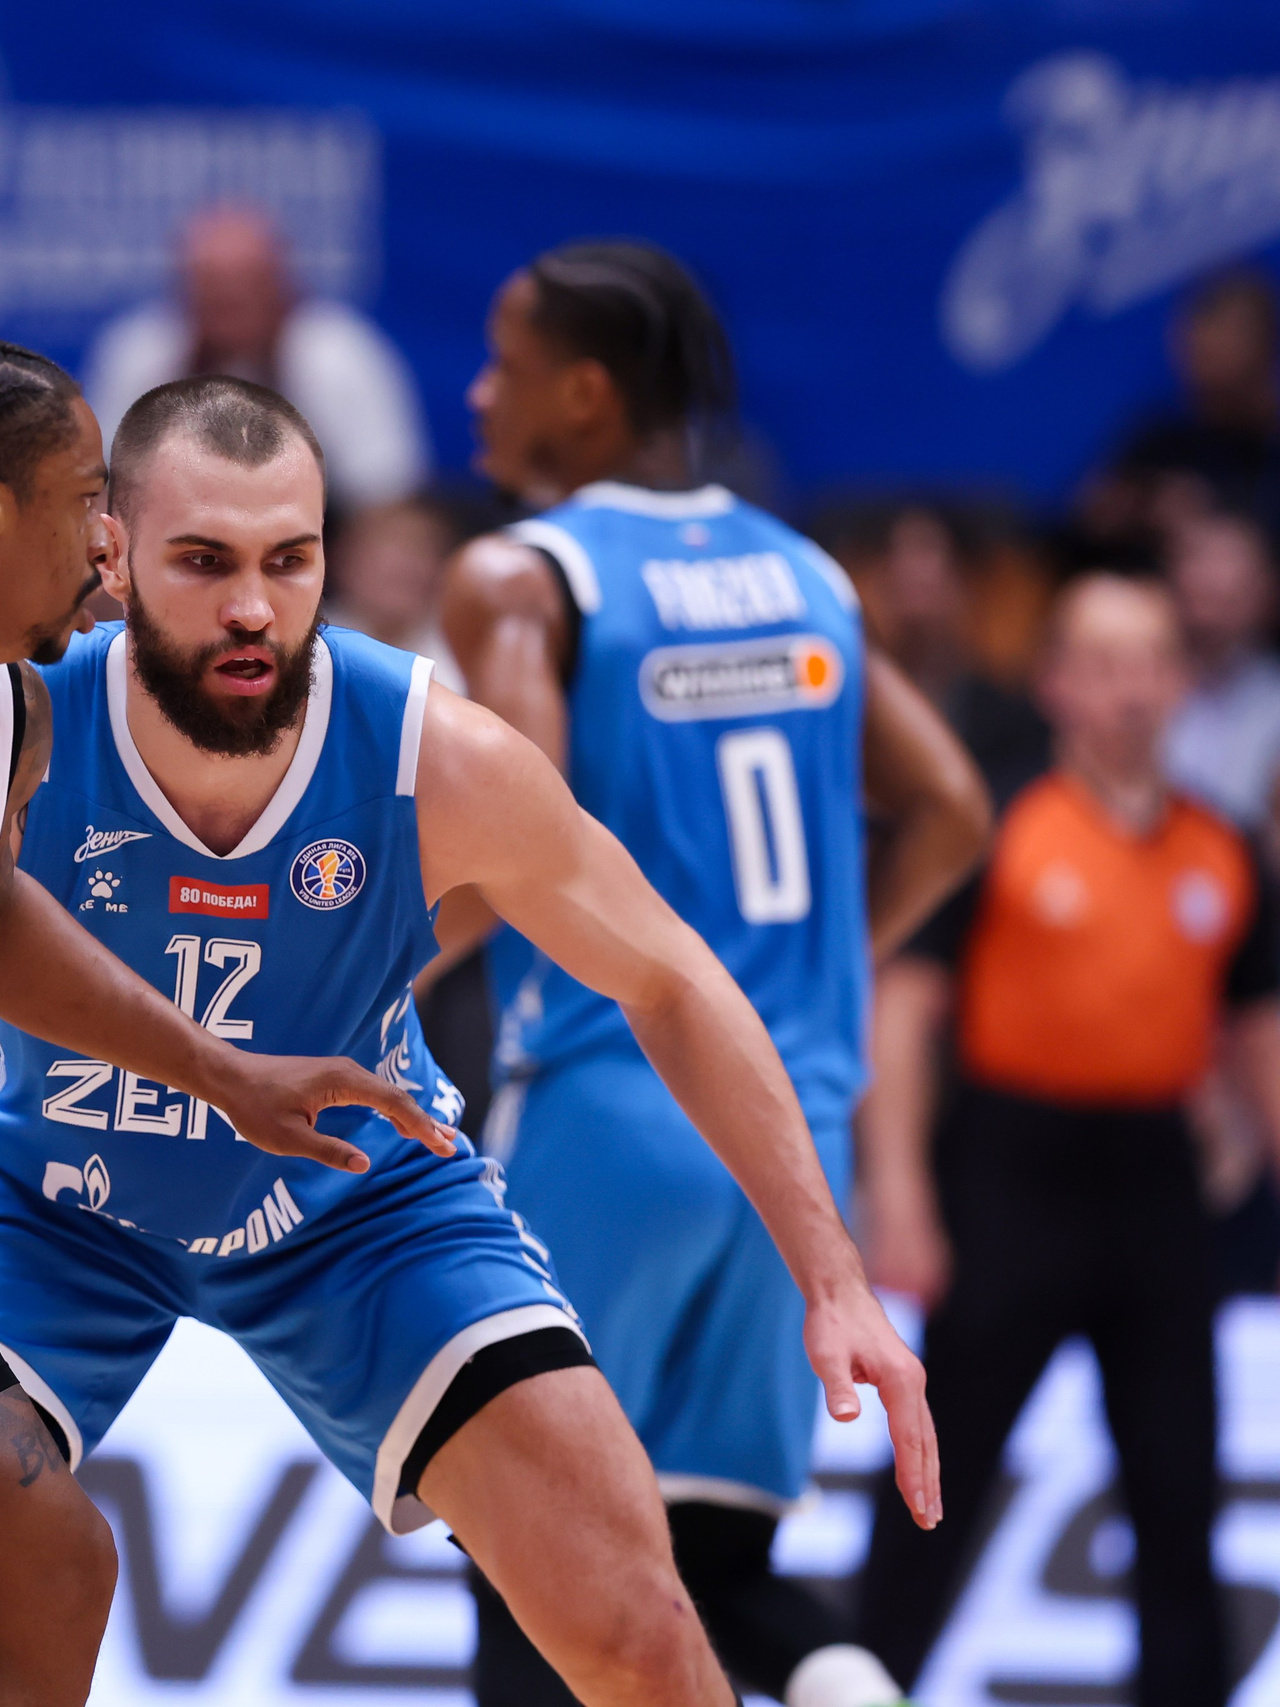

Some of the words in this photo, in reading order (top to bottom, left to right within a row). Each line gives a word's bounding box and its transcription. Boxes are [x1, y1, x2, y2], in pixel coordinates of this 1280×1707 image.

[716, 726, 811, 925] 0
[299, 843, 327, 865] ЕДИНАЯ
[328, 842, 347, 852] ЛИГА
[346, 848, 358, 861] ВТБ
[180, 887, 200, 903] 80
[203, 892, 257, 909] ПОБЕДА!
[298, 888, 310, 901] VTB
[308, 898, 335, 907] UNITED
[165, 934, 261, 1040] 12
[187, 1177, 305, 1257] ПРОМ
